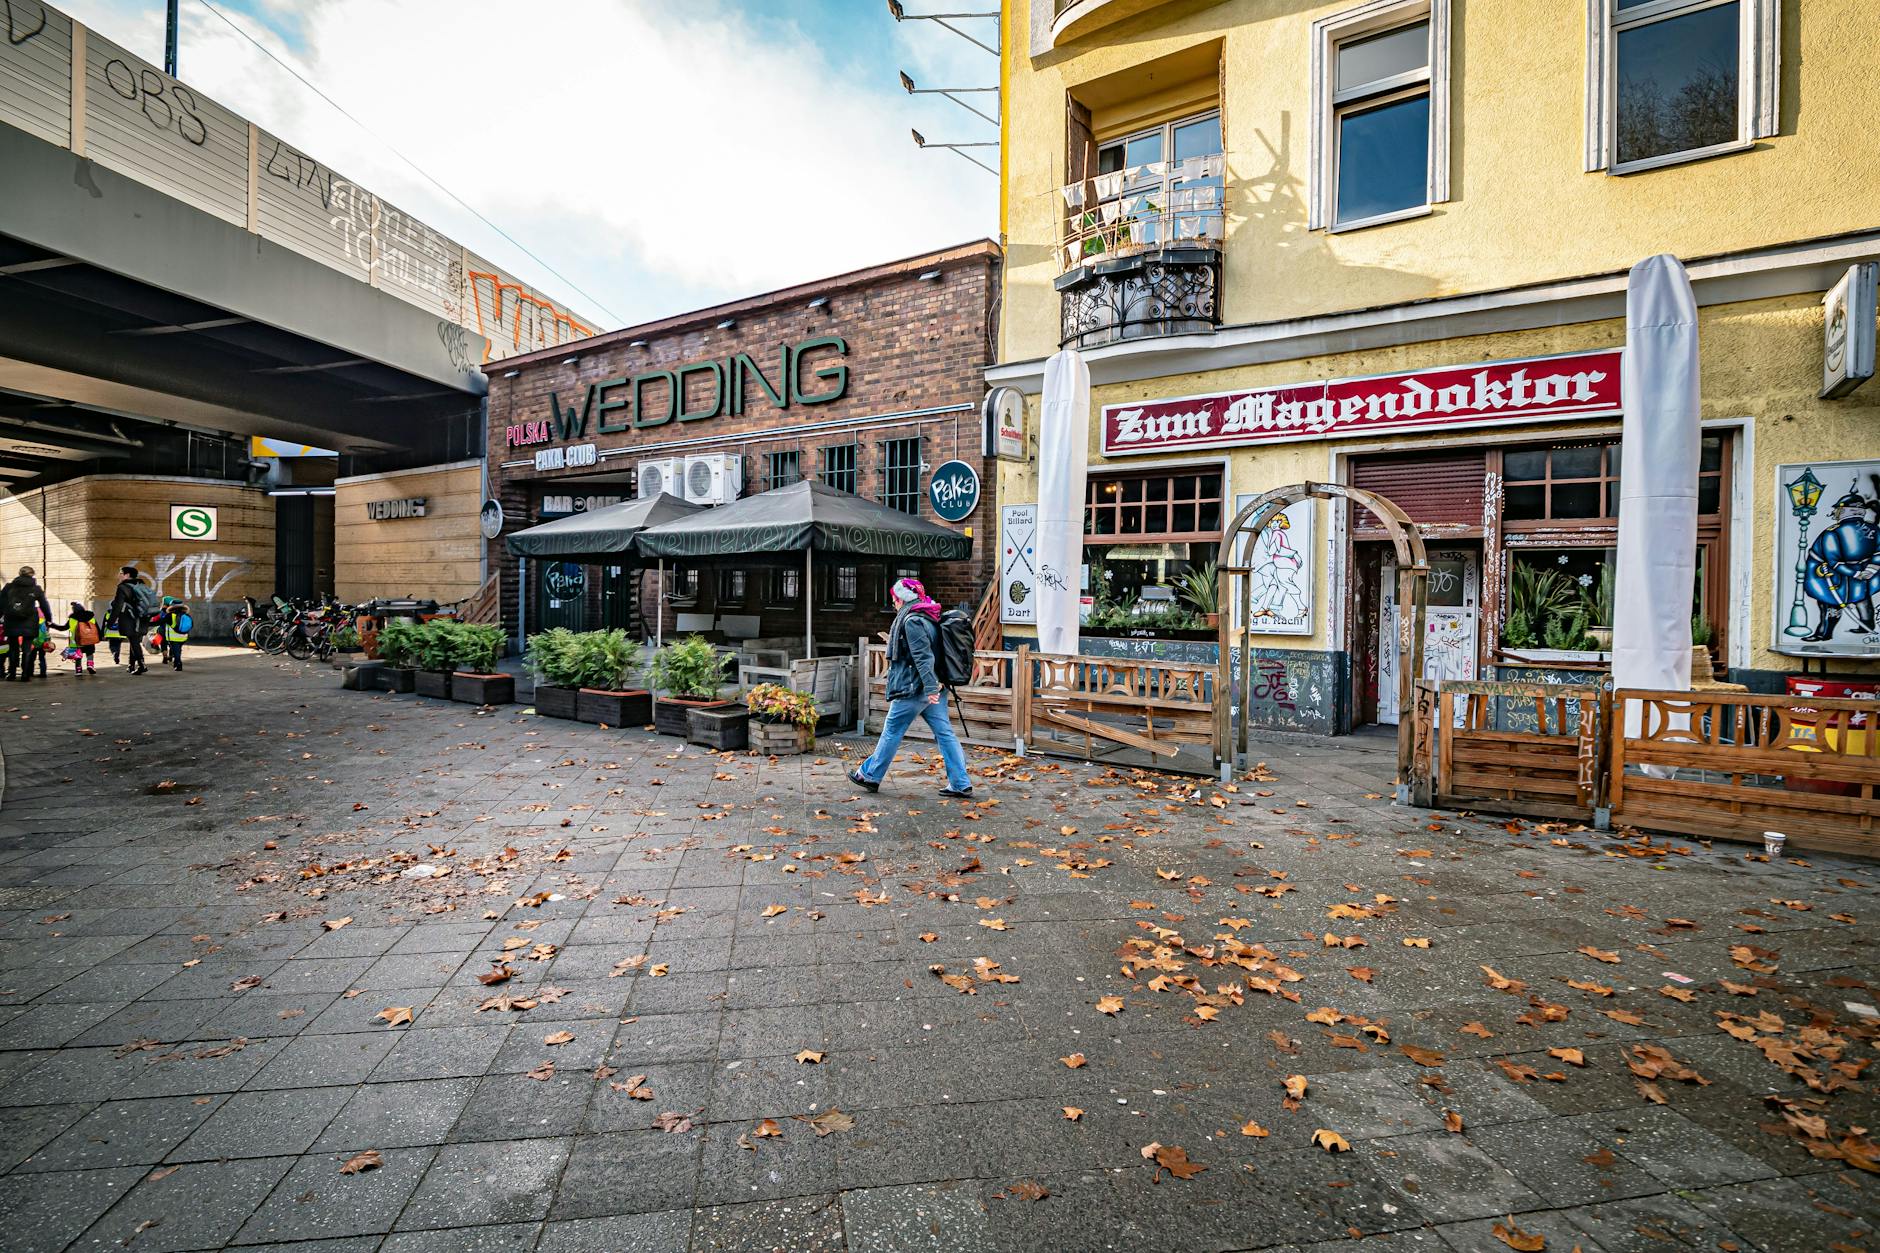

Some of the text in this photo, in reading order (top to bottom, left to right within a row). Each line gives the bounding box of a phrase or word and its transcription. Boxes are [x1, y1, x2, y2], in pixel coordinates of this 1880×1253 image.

[549, 335, 850, 441] WEDDING
[1113, 367, 1608, 444] Zum Magendoktor
[506, 421, 549, 447] POLSKA
[536, 443, 597, 471] PAKA CLUB
[367, 497, 425, 520] WEDDING
[543, 495, 573, 512] BAR
[1012, 509, 1028, 517] Pool
[182, 510, 208, 536] S
[1007, 517, 1033, 525] Billard
[822, 523, 970, 560] Heineken
[1007, 607, 1031, 617] Dart
[1272, 615, 1304, 625] Nacht
